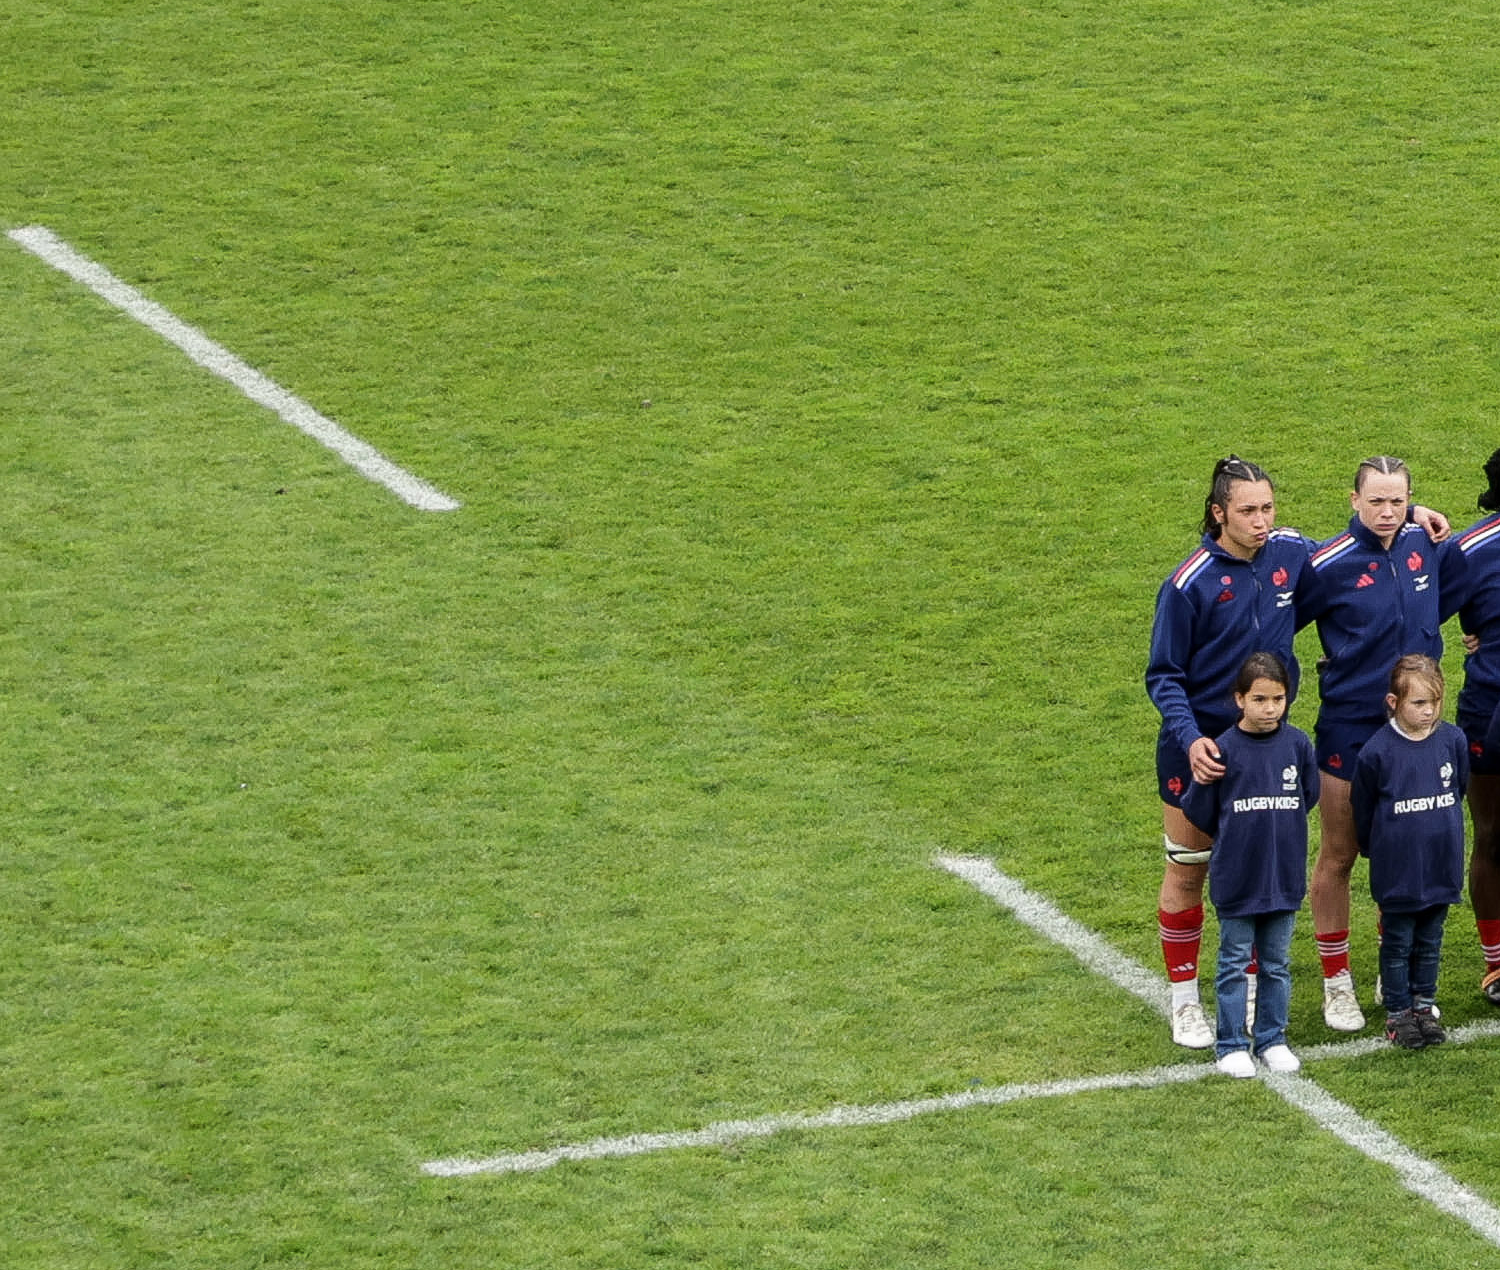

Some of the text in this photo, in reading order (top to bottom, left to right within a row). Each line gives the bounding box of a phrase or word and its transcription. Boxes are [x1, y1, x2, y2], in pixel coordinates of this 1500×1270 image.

[1234, 797, 1299, 812] RUGBY KIDS
[1394, 796, 1435, 814] RUGBY
